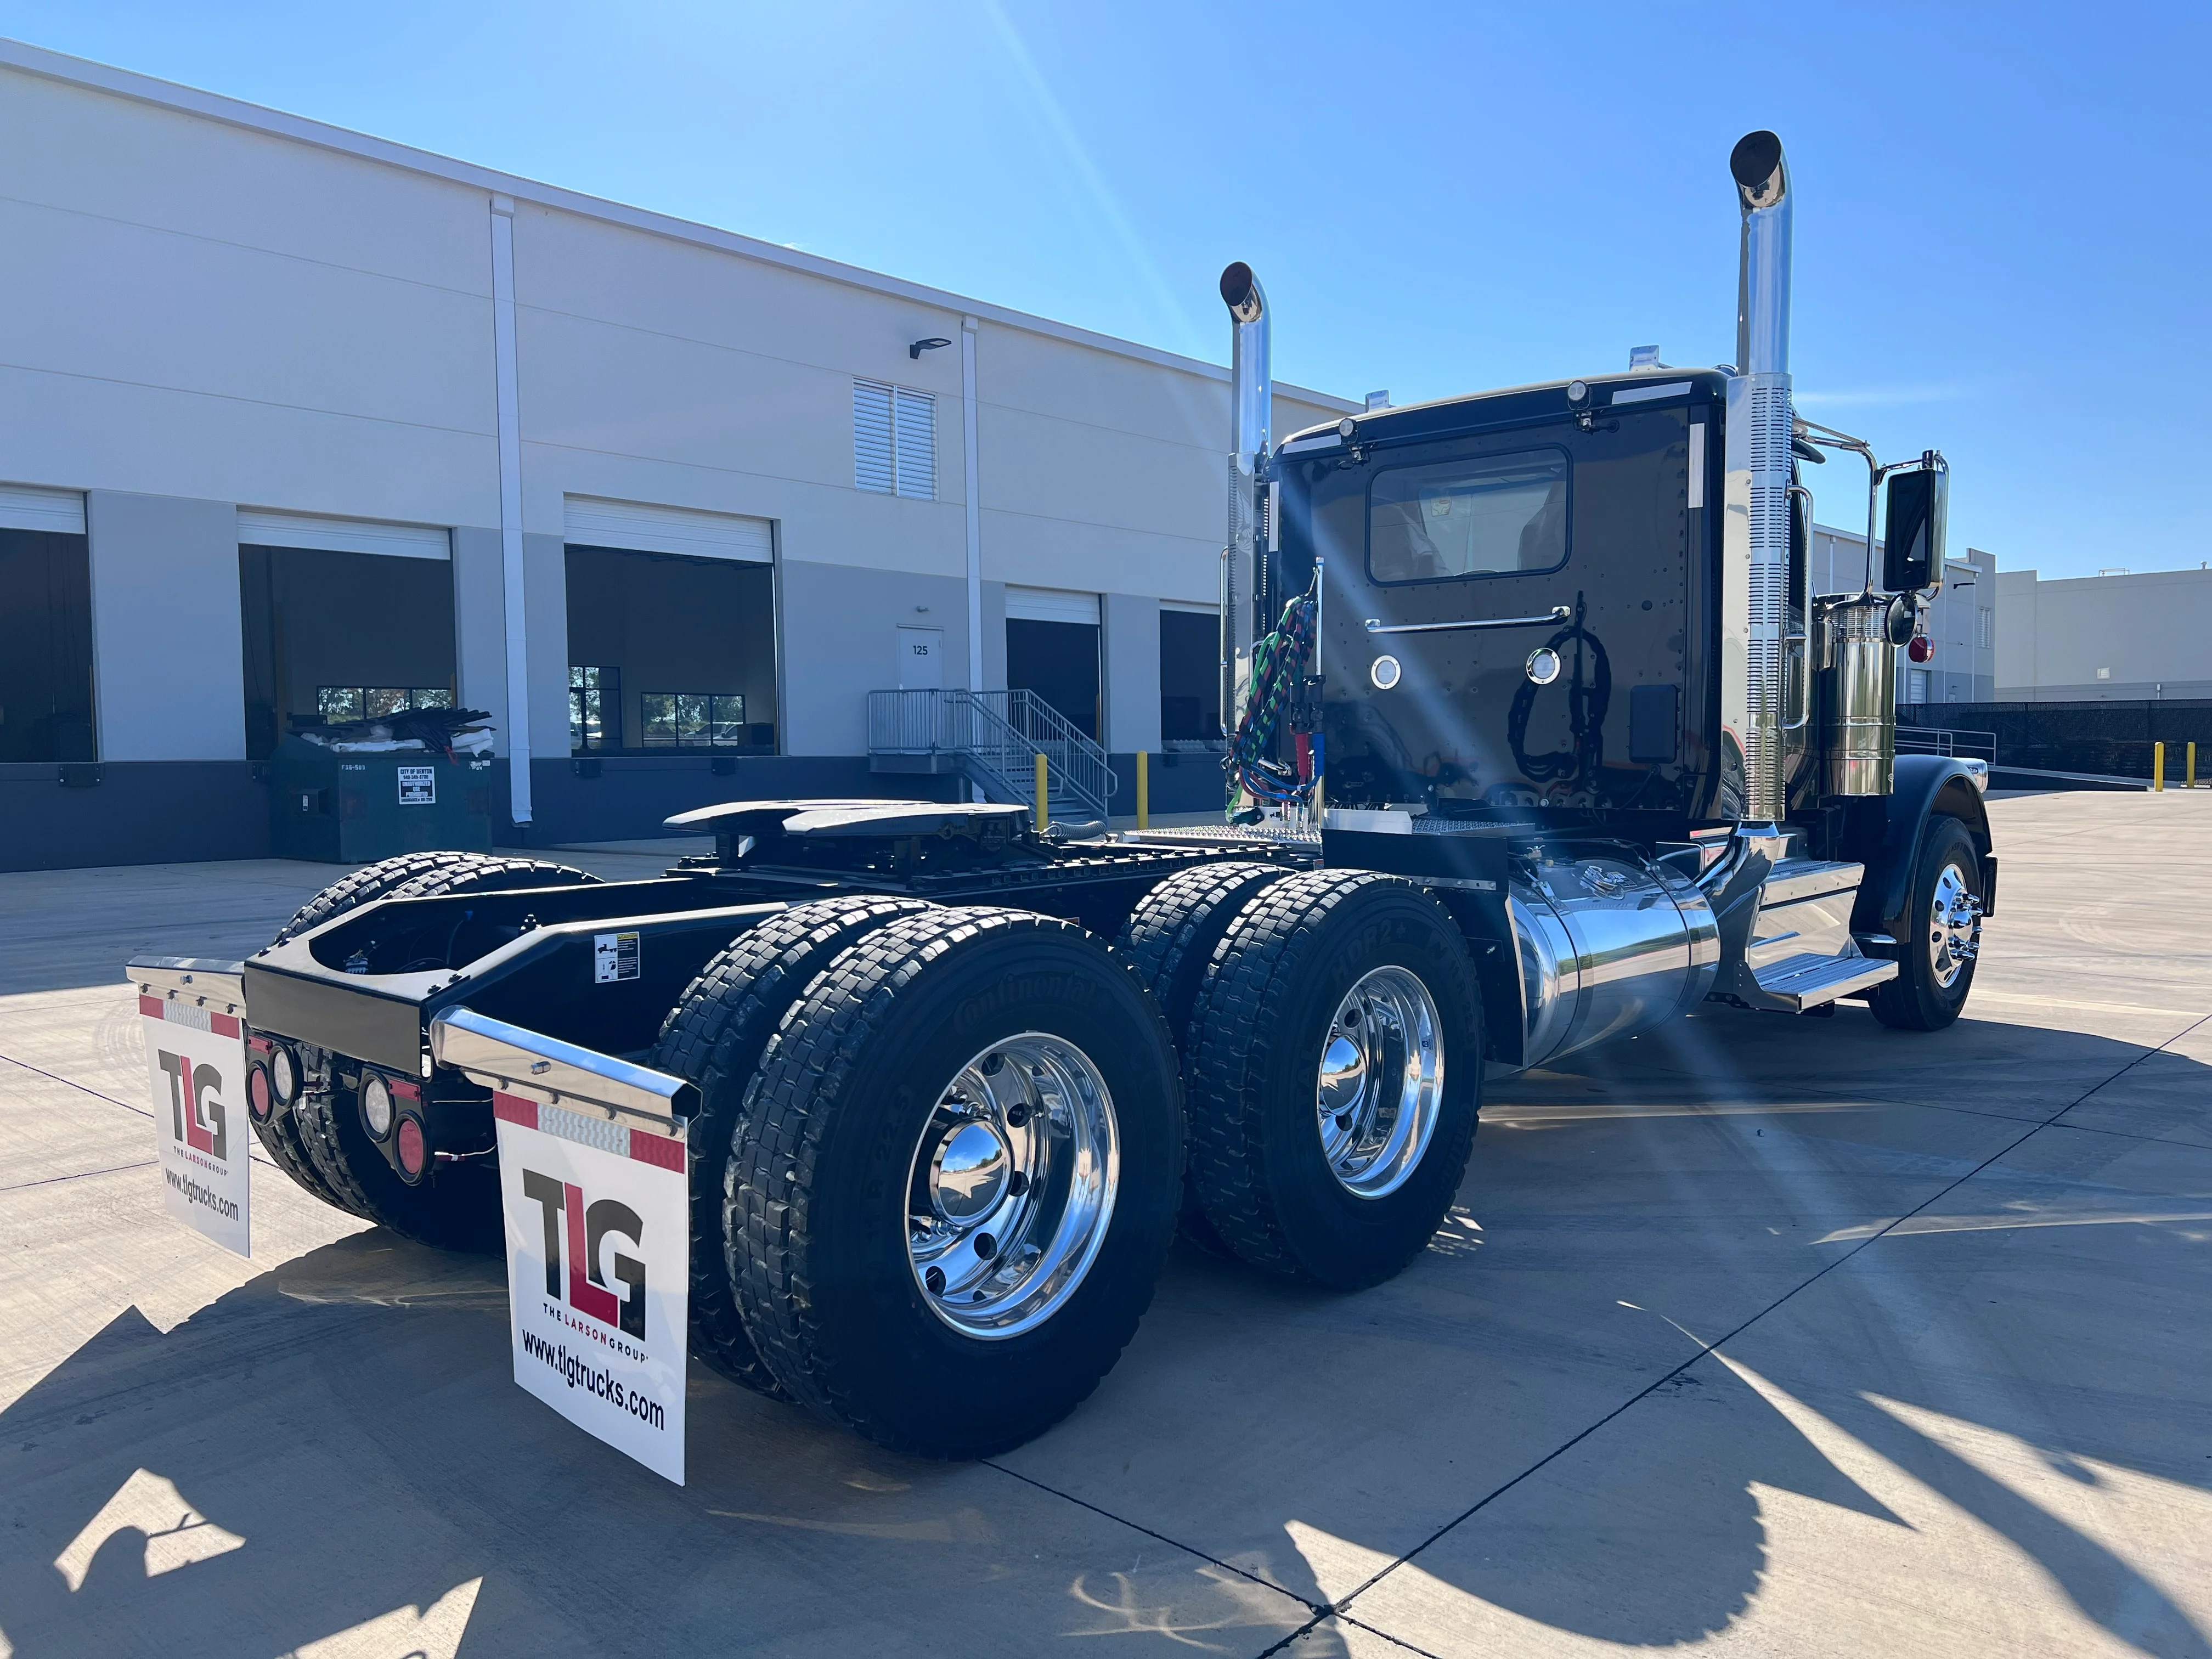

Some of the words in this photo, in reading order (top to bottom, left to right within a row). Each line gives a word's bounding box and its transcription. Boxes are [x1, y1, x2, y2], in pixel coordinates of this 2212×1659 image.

[913, 645, 928, 655] 125
[953, 970, 1096, 1035] Continental
[158, 1049, 227, 1161] TLG
[173, 1146, 183, 1157] THE
[165, 1167, 239, 1221] www.tlgtrucks.com
[522, 1168, 646, 1342] TLG
[543, 1302, 561, 1321] THE
[522, 1329, 664, 1431] www.tlgtrucks.com
